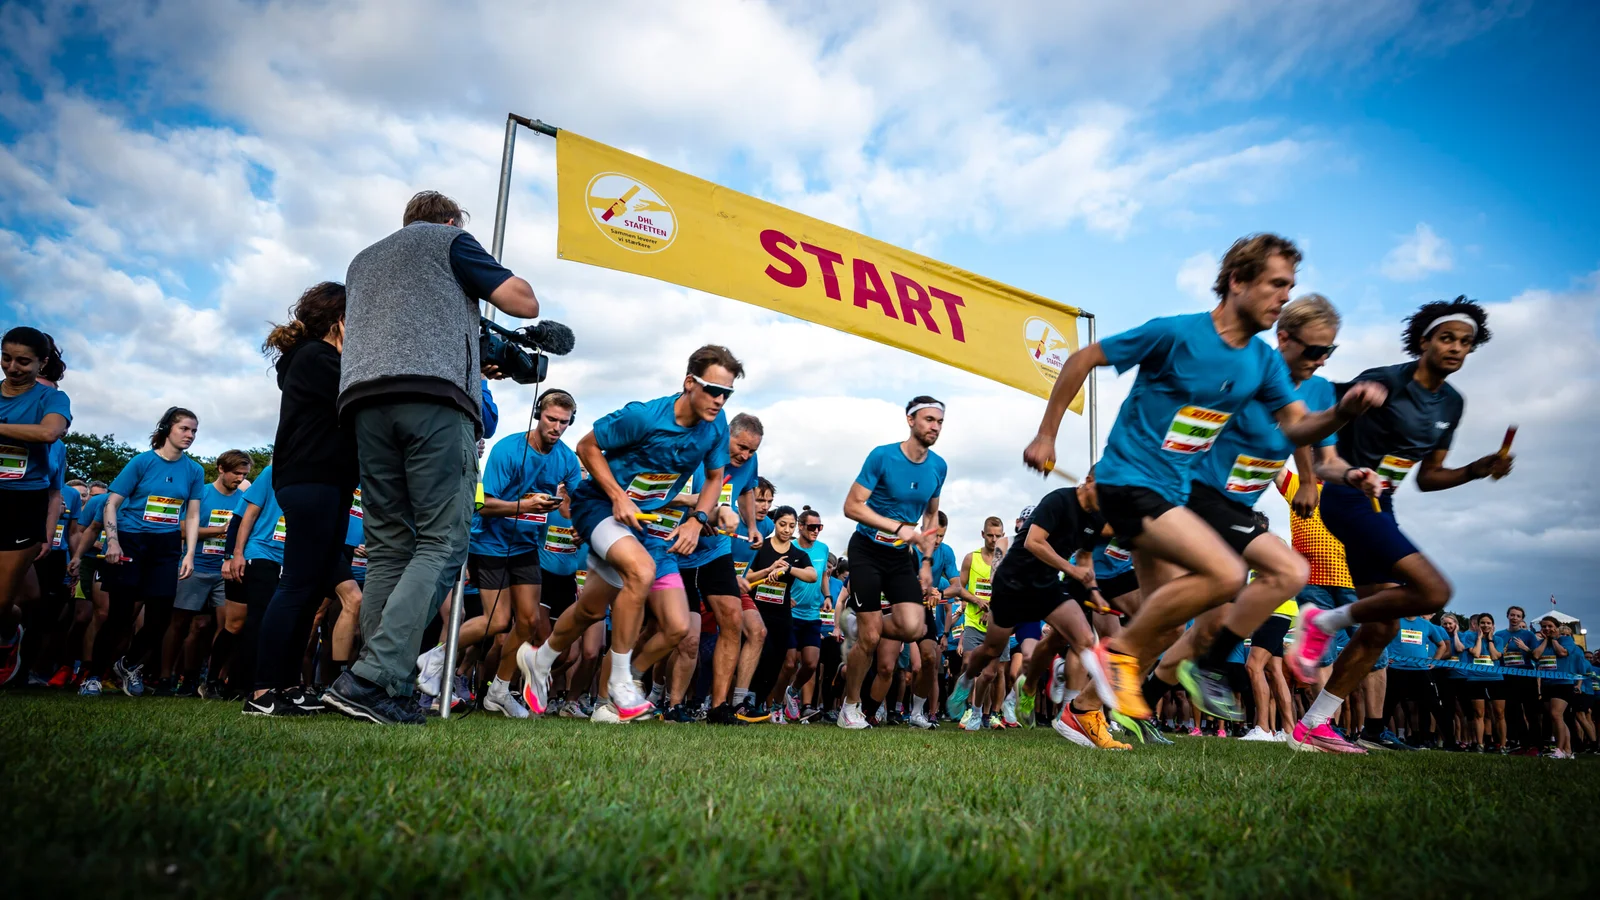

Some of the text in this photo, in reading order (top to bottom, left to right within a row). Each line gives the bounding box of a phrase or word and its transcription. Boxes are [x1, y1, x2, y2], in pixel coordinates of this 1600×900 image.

[637, 215, 653, 226] DHL
[624, 220, 667, 237] STAFETTEN
[610, 228, 657, 245] Sammen leverer
[759, 229, 966, 343] START
[1190, 409, 1224, 422] DHL
[157, 496, 176, 504] DHL
